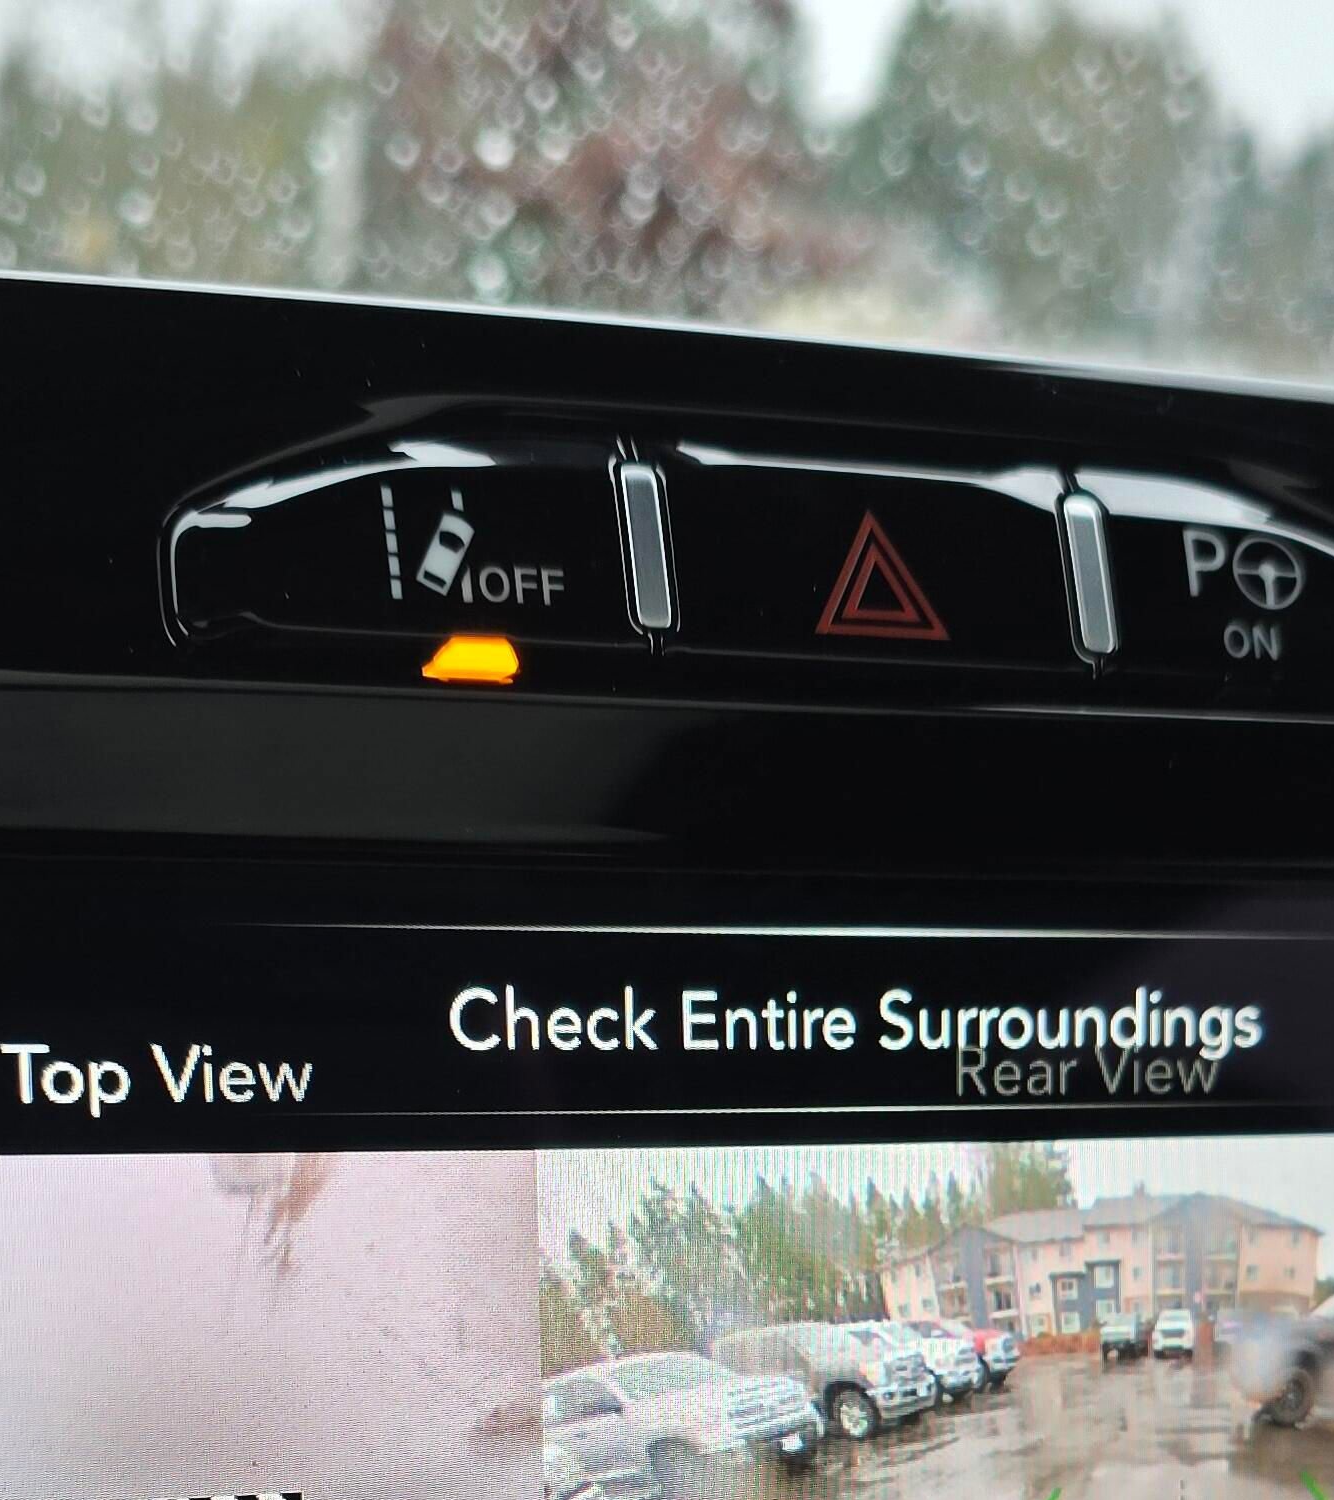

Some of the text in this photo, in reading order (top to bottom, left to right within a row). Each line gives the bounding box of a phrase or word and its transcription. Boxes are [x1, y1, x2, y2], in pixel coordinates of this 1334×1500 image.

[480, 567, 564, 605] OFF
[1224, 623, 1279, 660] ON
[450, 984, 1264, 1060] Check Entire Surroundings
[0, 1044, 312, 1117] Top View
[955, 1042, 1220, 1097] Rear View
